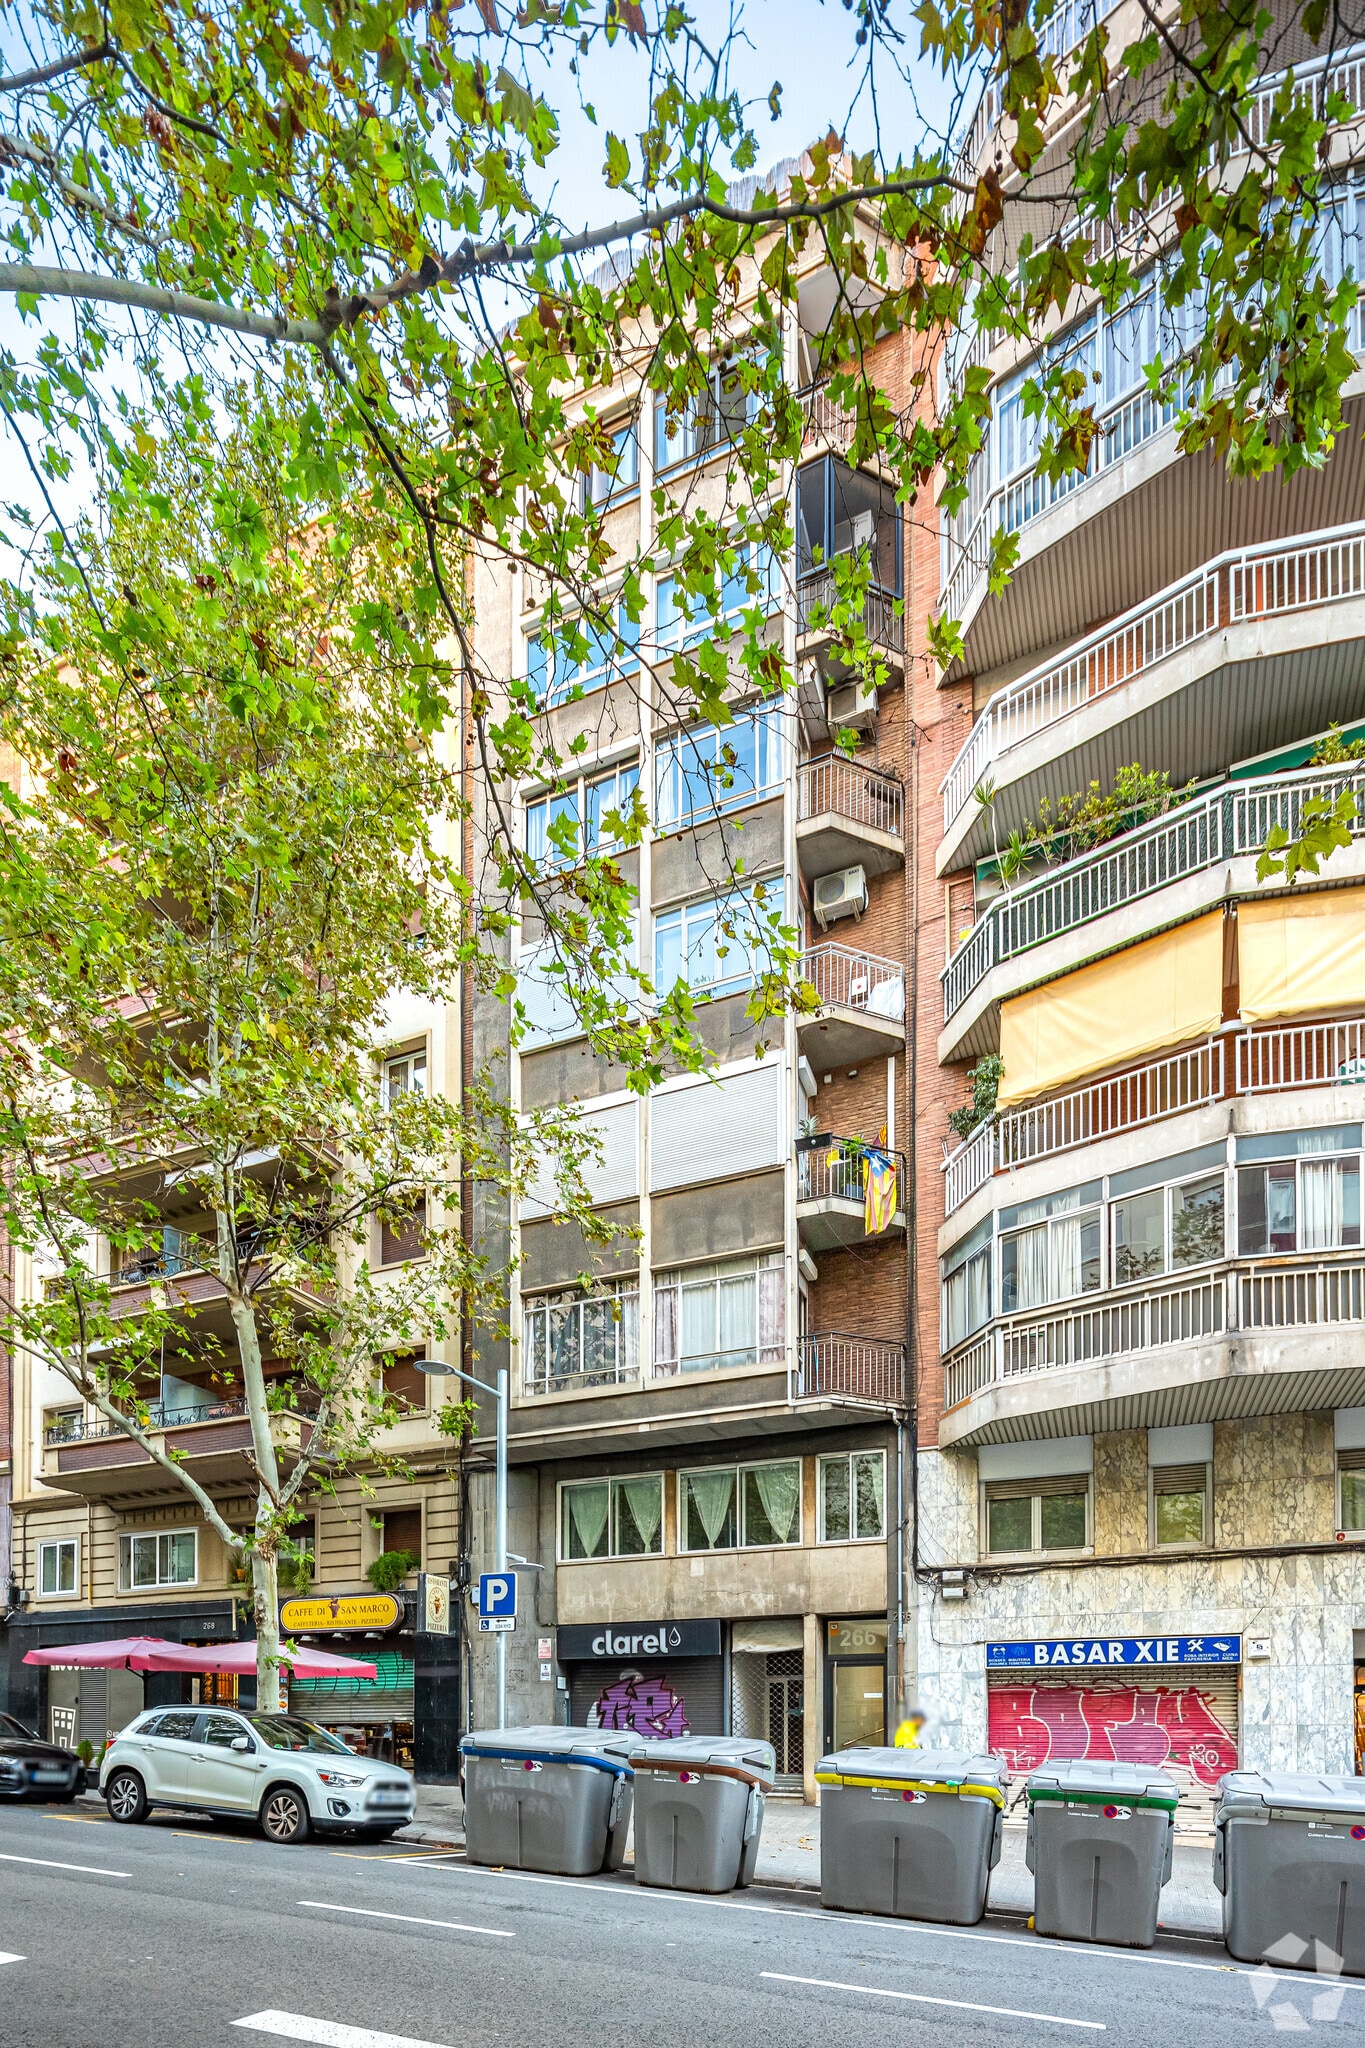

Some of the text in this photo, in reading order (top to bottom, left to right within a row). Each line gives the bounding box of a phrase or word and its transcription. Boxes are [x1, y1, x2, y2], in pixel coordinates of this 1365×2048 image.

[486, 1578, 509, 1612] P
[288, 1603, 390, 1617] CAFFE DI SAN MARCO
[361, 1617, 384, 1625] PIZZERIA
[592, 1627, 669, 1655] clarel
[839, 1628, 877, 1647] 266
[1034, 1640, 1179, 1665] BASAR XIE
